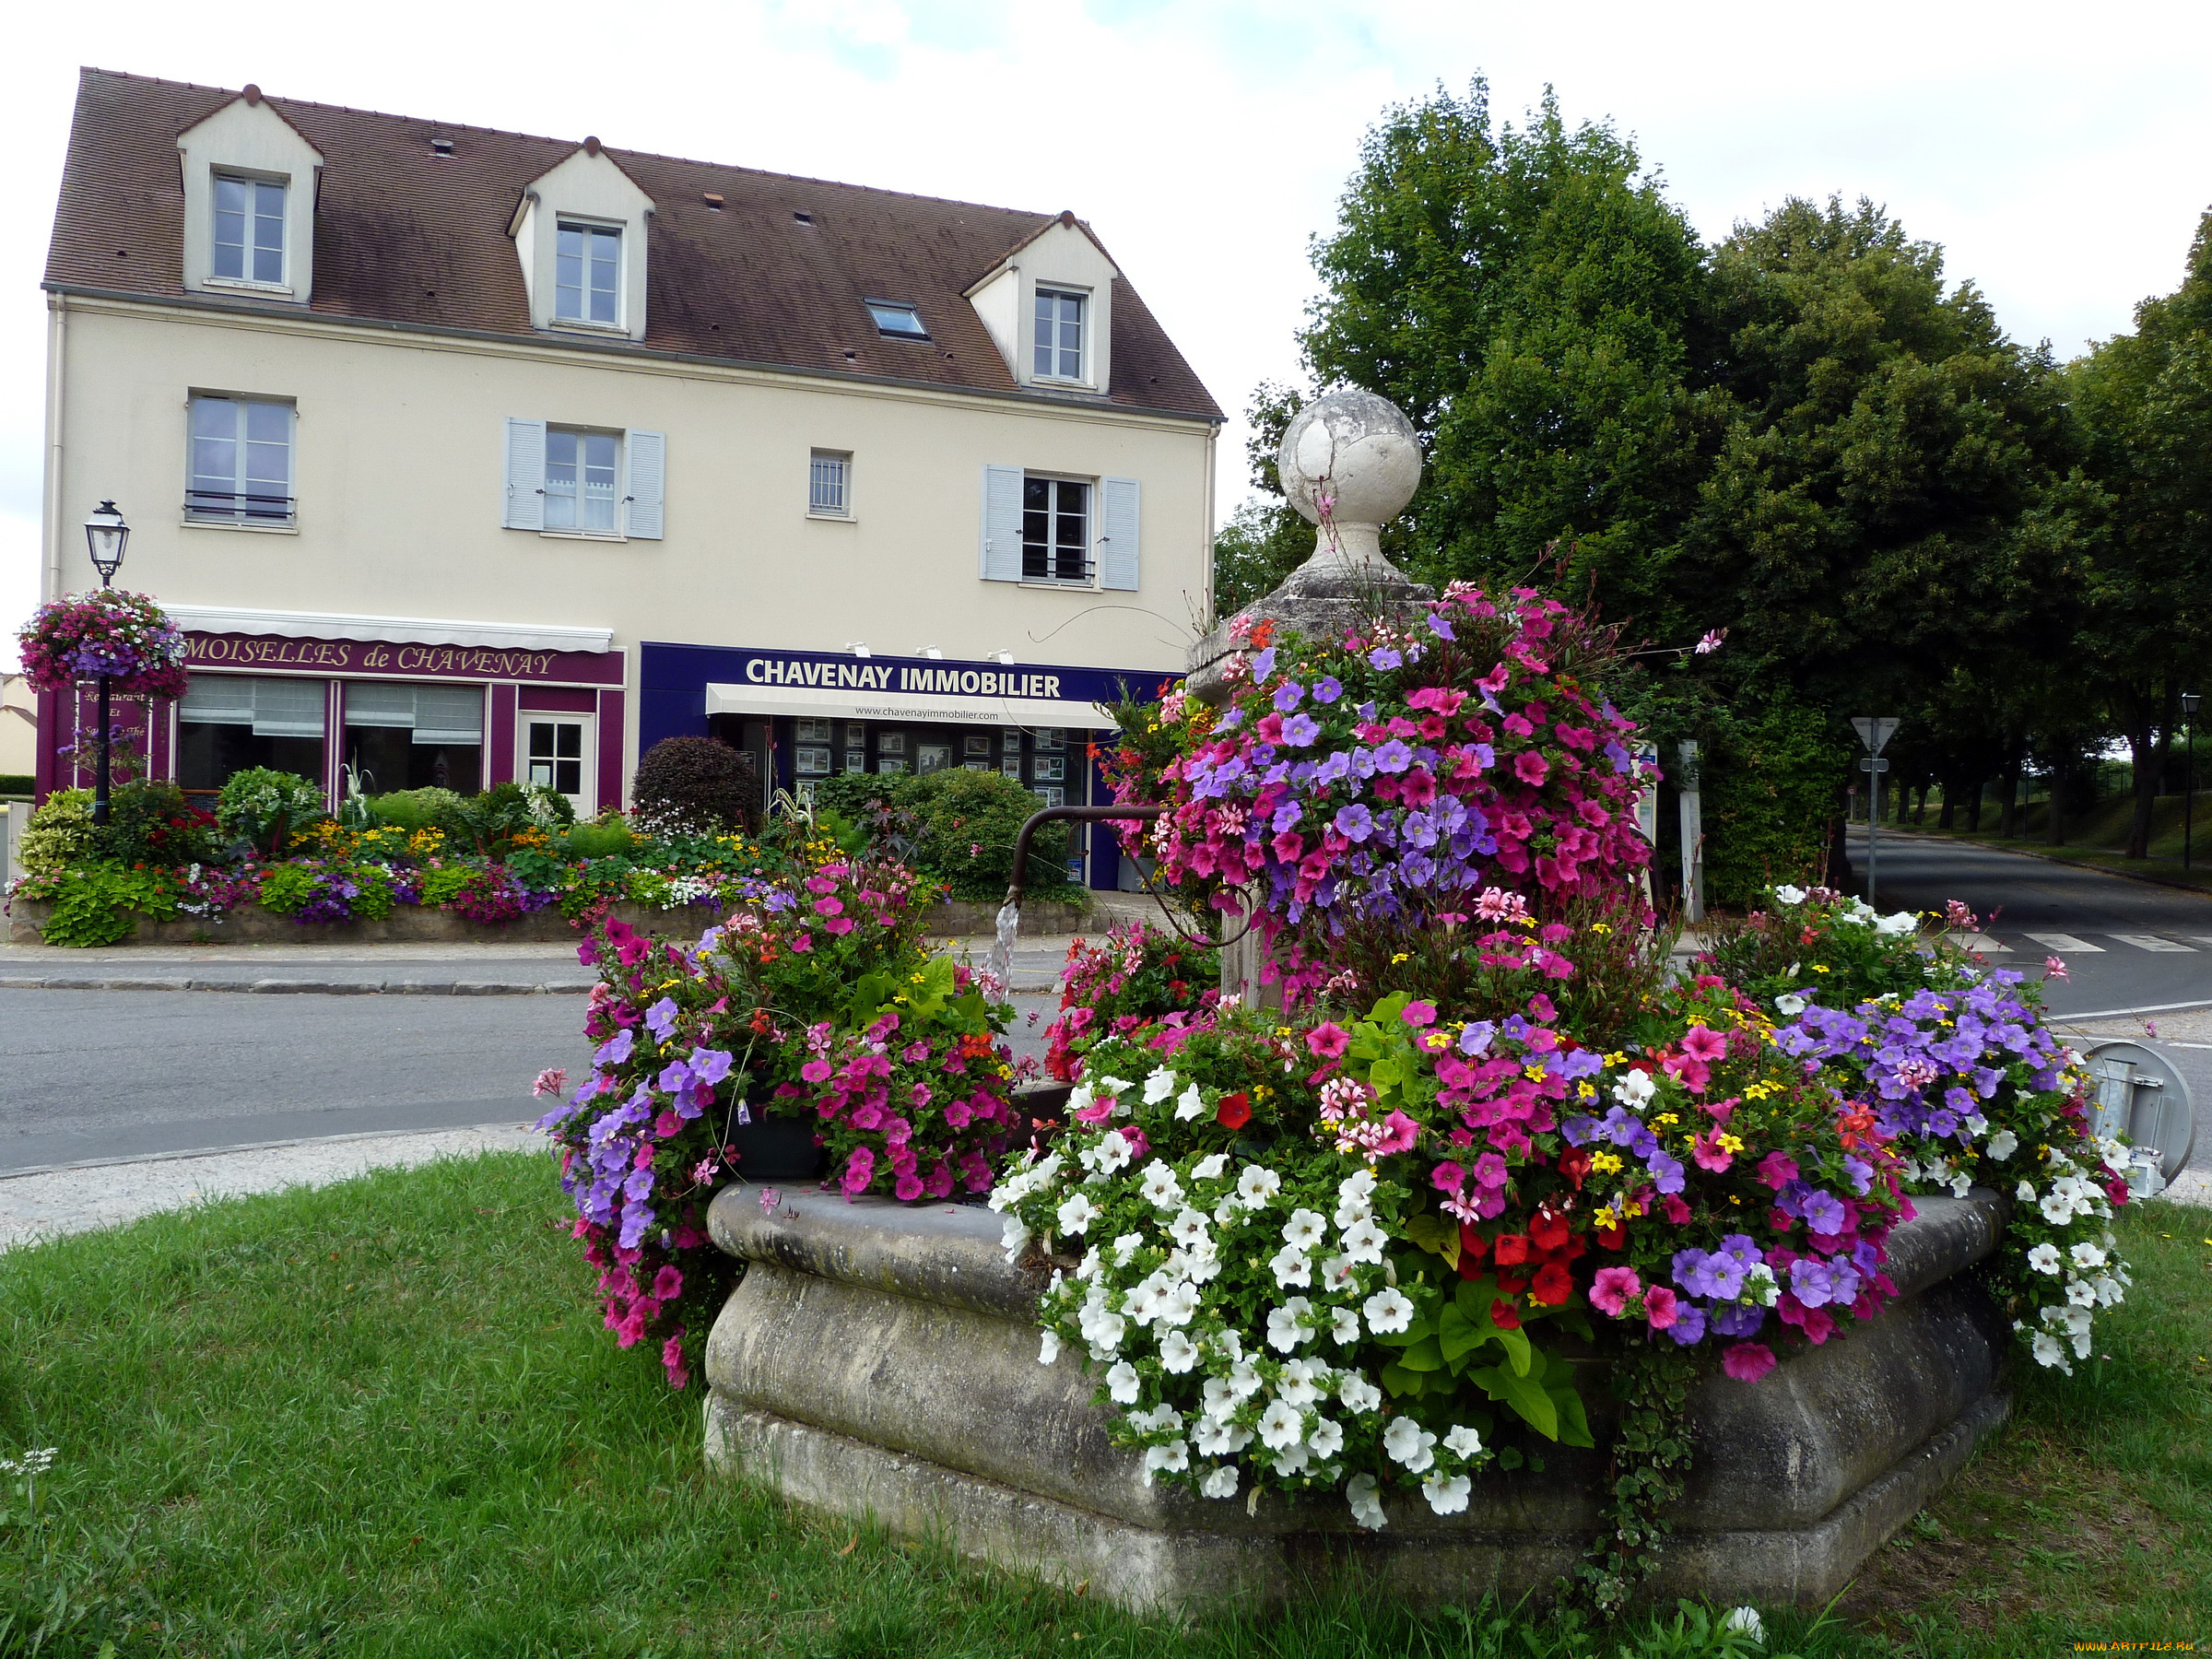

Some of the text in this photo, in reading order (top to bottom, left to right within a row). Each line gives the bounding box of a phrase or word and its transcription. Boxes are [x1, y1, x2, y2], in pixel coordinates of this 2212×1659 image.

[363, 645, 389, 667] de
[397, 647, 558, 676] CHAVENAY
[746, 659, 1061, 698] CHAVENAY IMMOBILIER
[84, 691, 146, 702] Reaurant
[109, 708, 121, 716] Et
[855, 707, 999, 721] www.chavenayimmobilier.com
